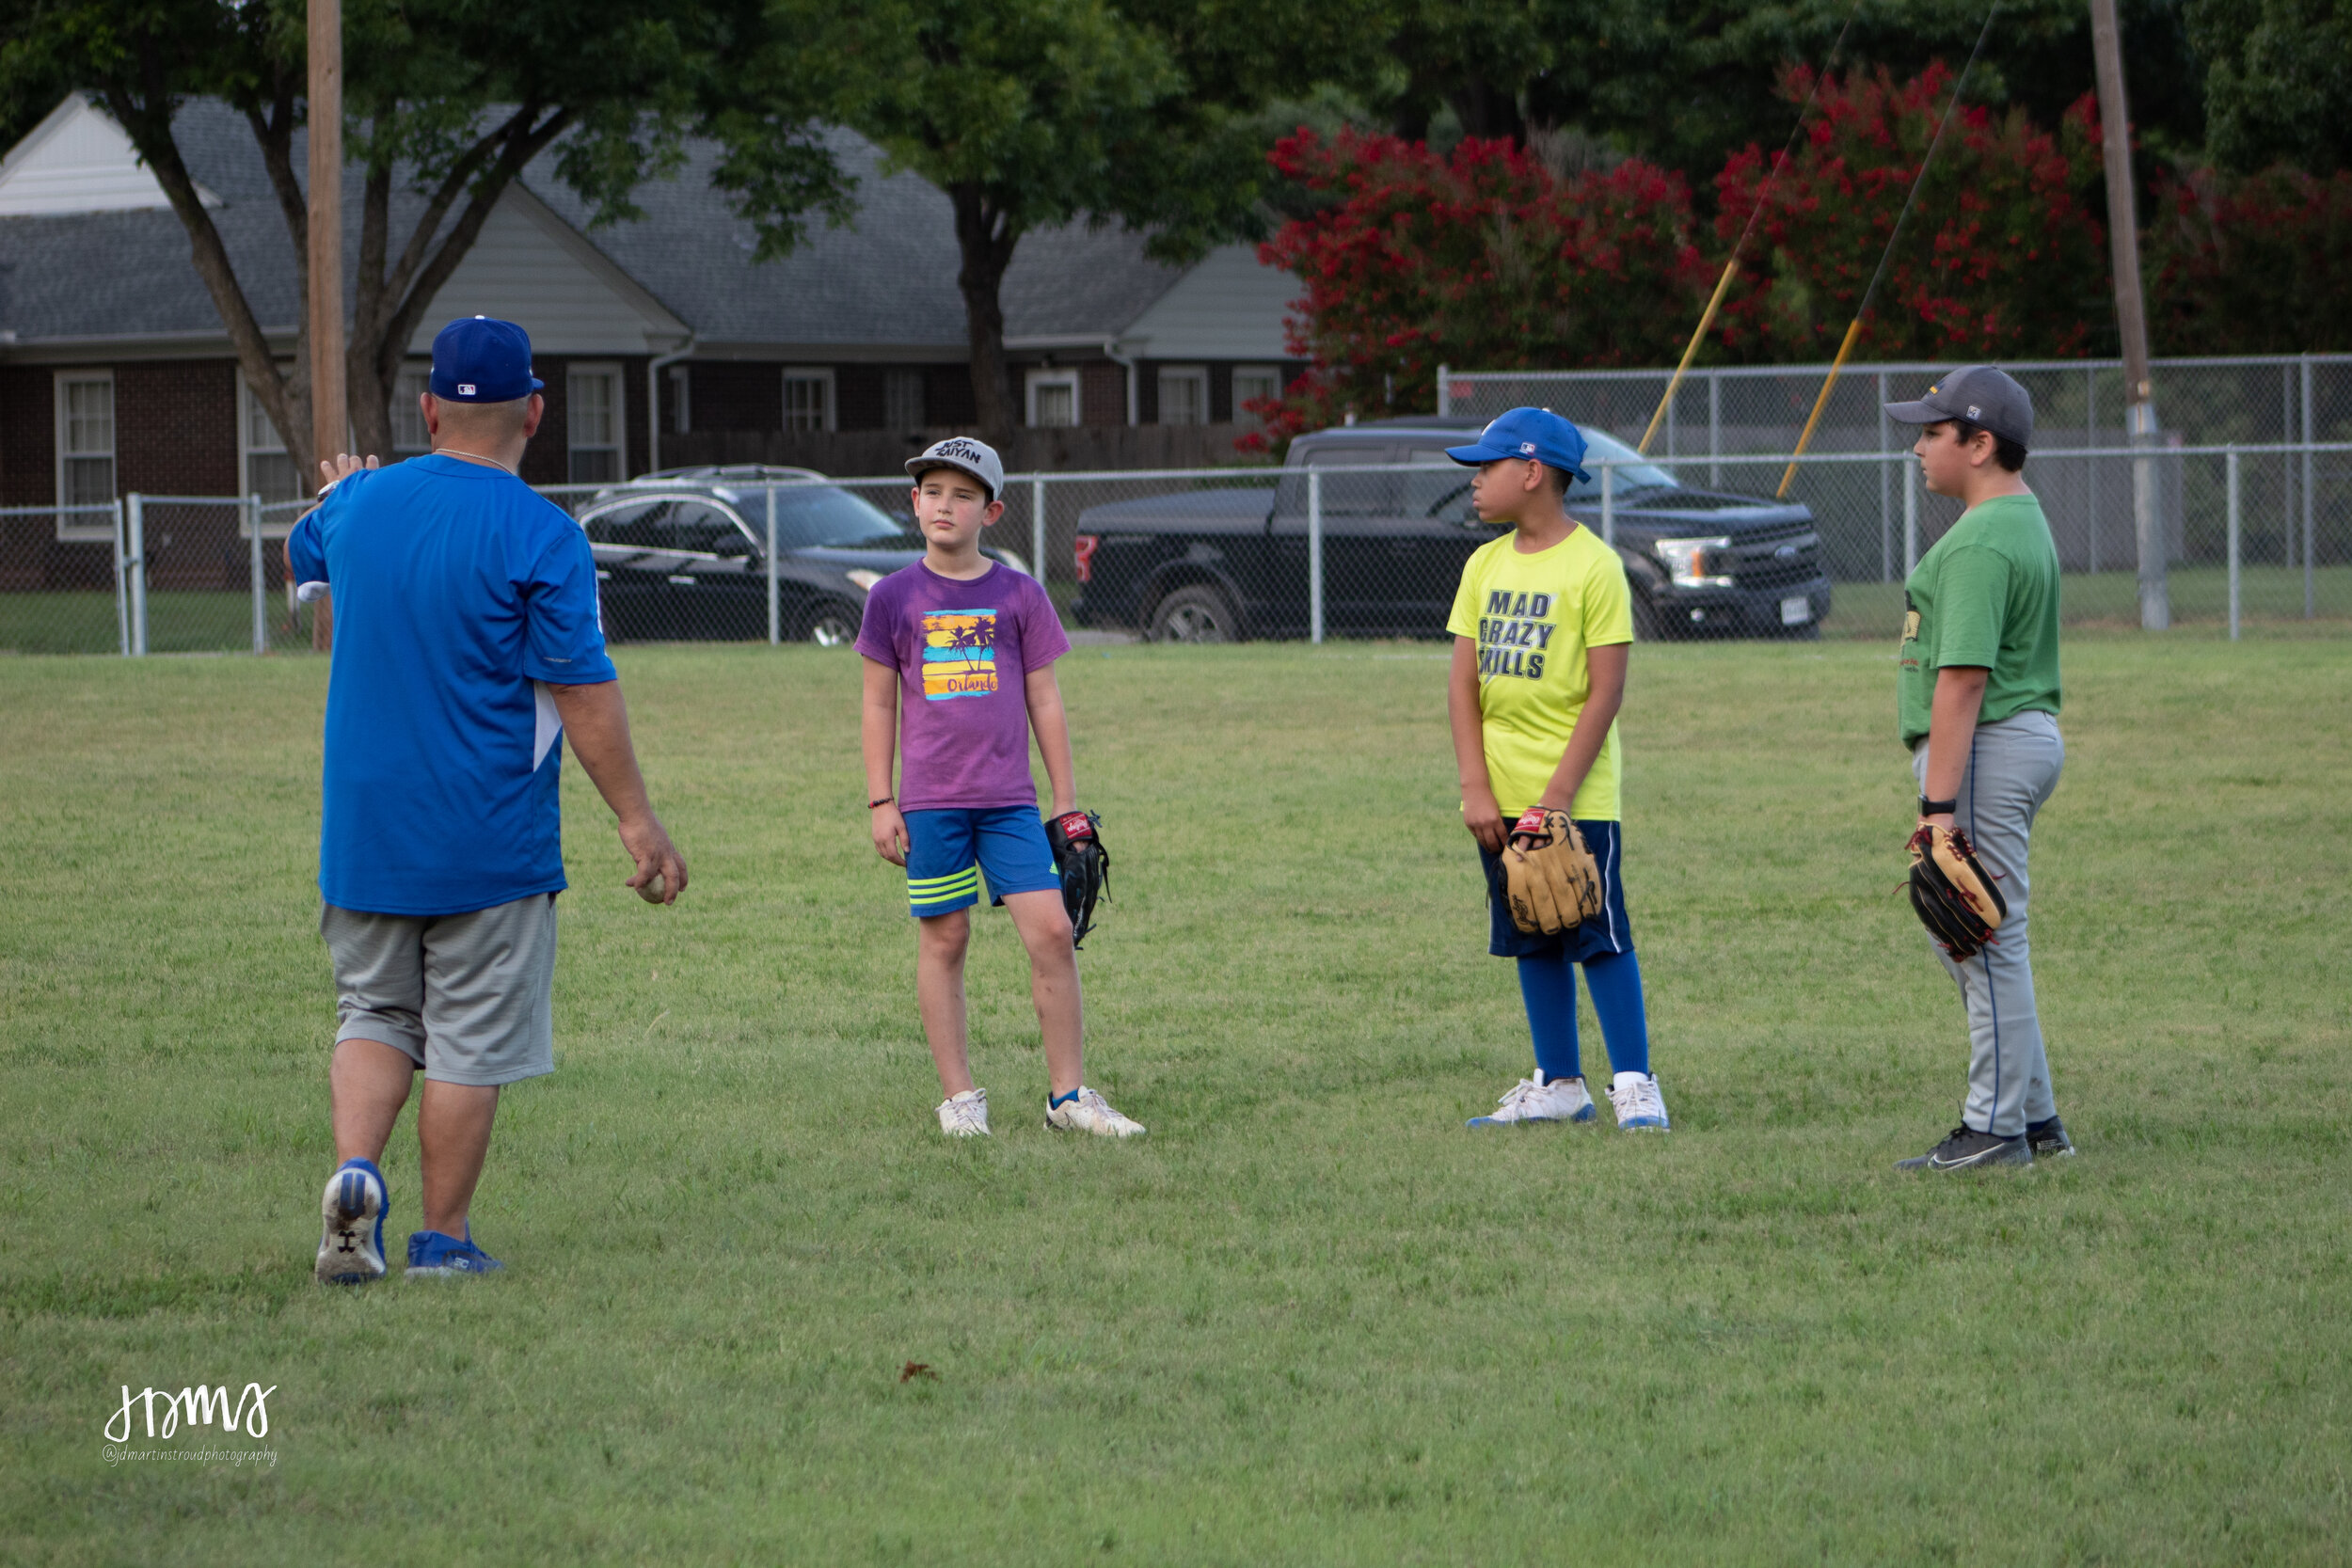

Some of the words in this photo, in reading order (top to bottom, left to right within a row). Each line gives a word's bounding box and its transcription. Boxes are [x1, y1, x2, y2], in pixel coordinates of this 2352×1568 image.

[940, 439, 974, 450] JUST
[1485, 589, 1550, 619] MAD
[1478, 617, 1556, 650] CRAZY
